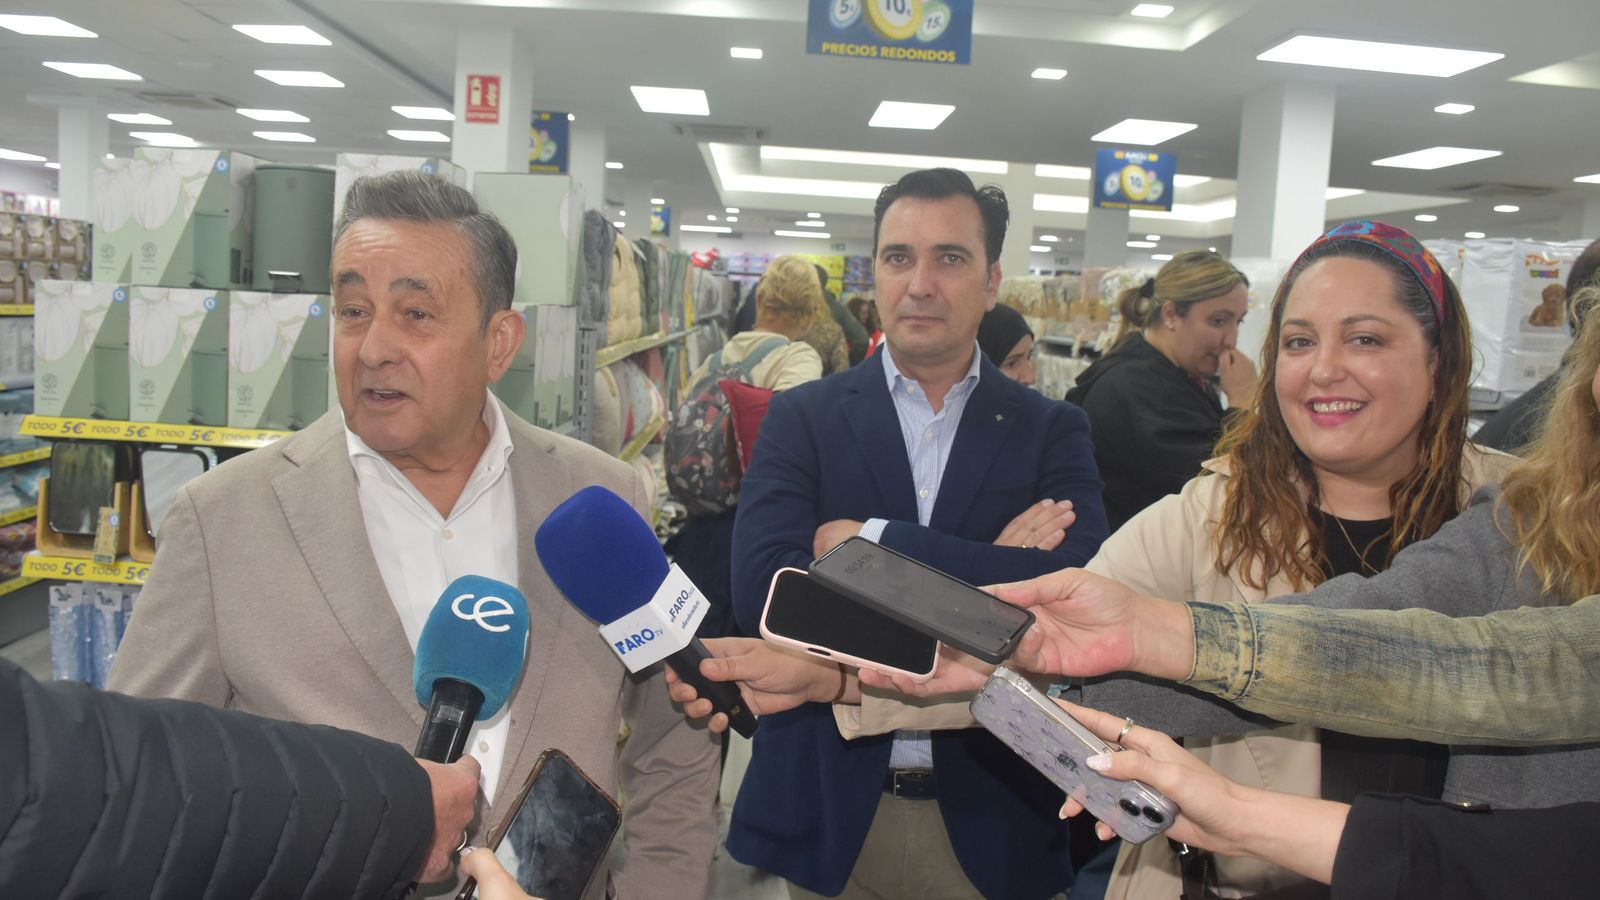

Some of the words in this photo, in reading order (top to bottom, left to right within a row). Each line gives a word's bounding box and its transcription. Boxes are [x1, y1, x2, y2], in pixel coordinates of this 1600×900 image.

[822, 42, 877, 56] PRECIOS
[881, 47, 956, 62] REDONDOS
[28, 421, 57, 431] TODO
[61, 421, 87, 434] 5€
[92, 425, 120, 434] TODO
[124, 425, 150, 438] 5€
[155, 428, 185, 438] TODO
[189, 429, 215, 441] 5€
[29, 562, 58, 572] TODO
[62, 561, 87, 576] 5€
[92, 566, 120, 576] TODO
[125, 566, 150, 580] 5€
[669, 589, 689, 619] FARO
[614, 628, 655, 656] FARO
[655, 628, 664, 637] TV
